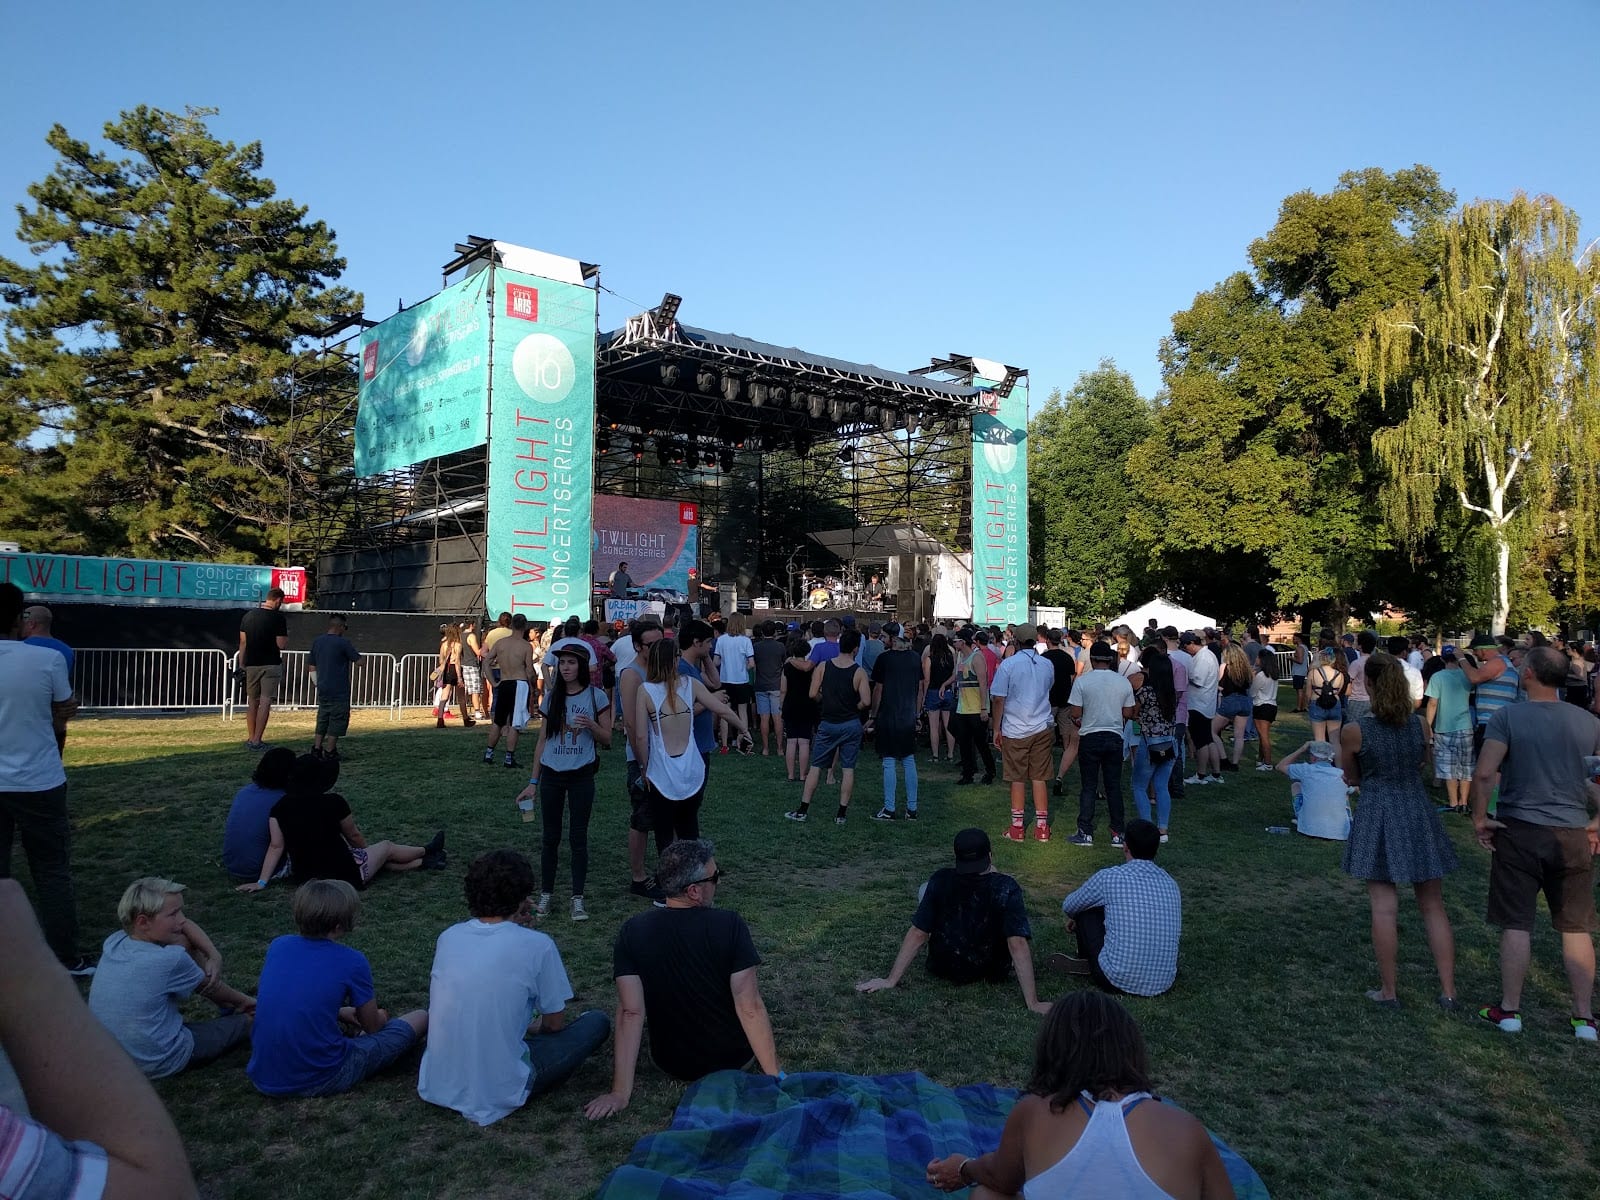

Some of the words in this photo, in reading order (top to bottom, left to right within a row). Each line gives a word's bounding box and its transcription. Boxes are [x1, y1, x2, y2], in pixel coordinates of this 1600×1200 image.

[513, 297, 532, 315] ARTS
[511, 408, 550, 613] TWILIGHT
[600, 529, 666, 549] TWILIGHT
[986, 479, 1005, 624] TWILIGHT
[0, 556, 188, 594] TWILIGHT
[195, 567, 262, 581] CONCERT
[279, 573, 300, 582] CITY
[195, 581, 262, 598] SERIES
[608, 600, 637, 611] URBAN
